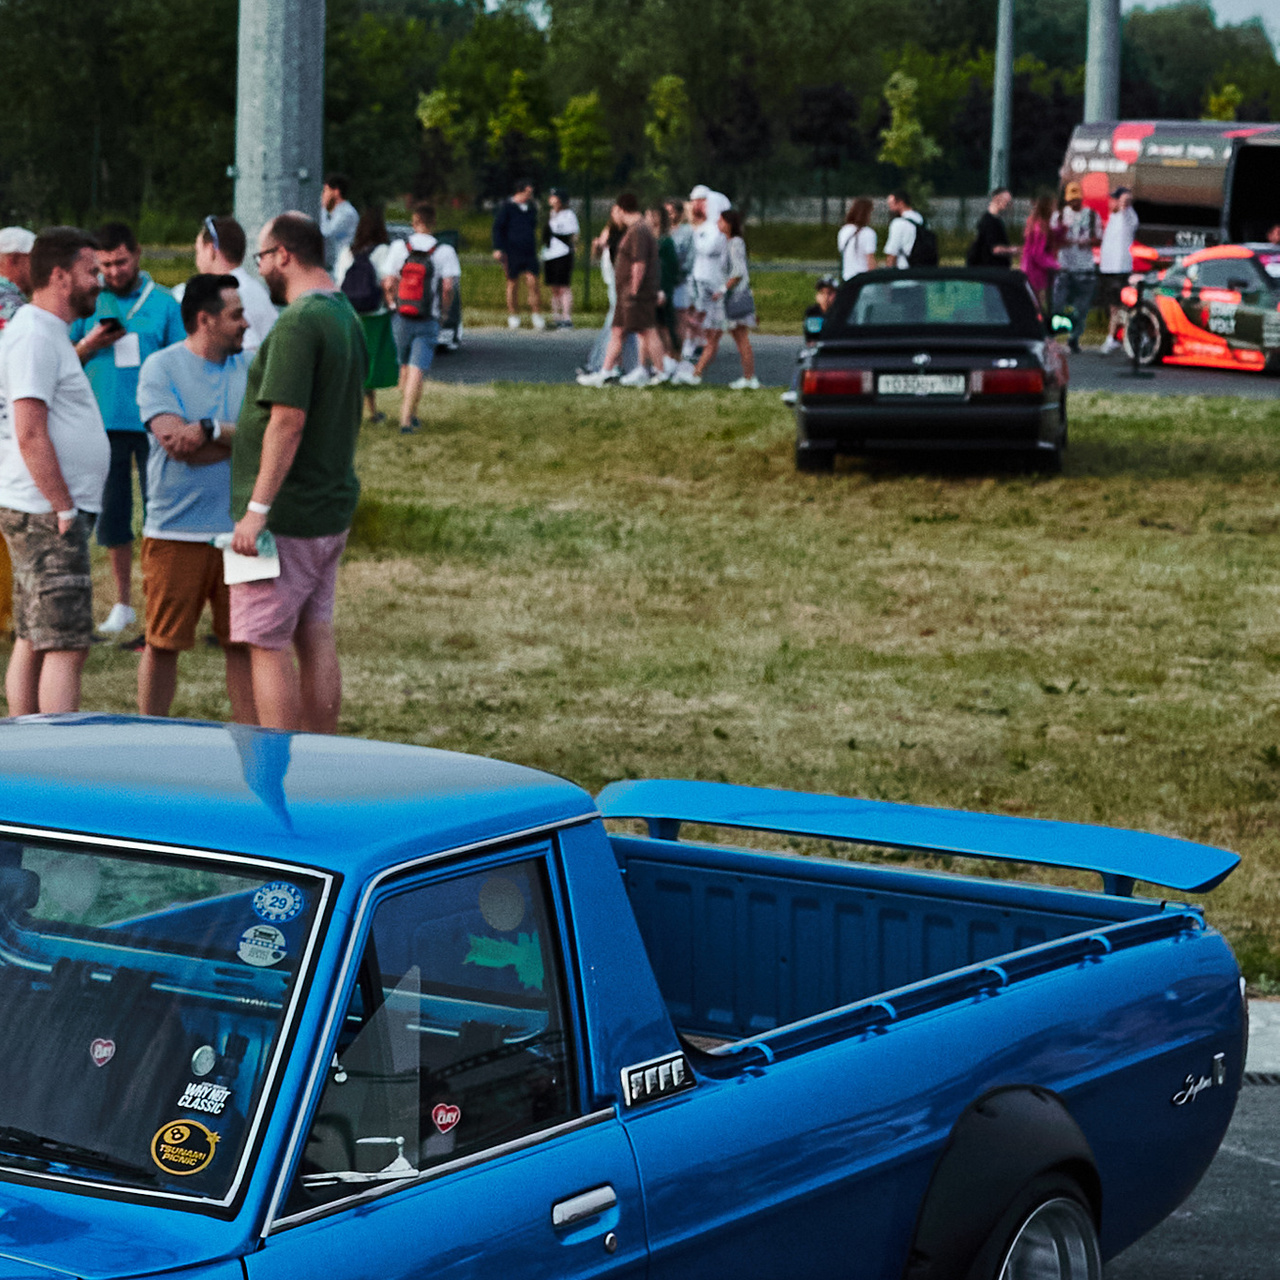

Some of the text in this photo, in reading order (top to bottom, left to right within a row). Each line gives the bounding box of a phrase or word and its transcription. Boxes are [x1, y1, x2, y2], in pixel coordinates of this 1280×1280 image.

[269, 896, 287, 910] 29
[185, 1082, 212, 1098] WHY
[208, 1088, 231, 1103] NOT
[177, 1095, 225, 1114] CLASSIC
[160, 1144, 206, 1160] TSUNAMI
[162, 1152, 197, 1166] PICNIC
